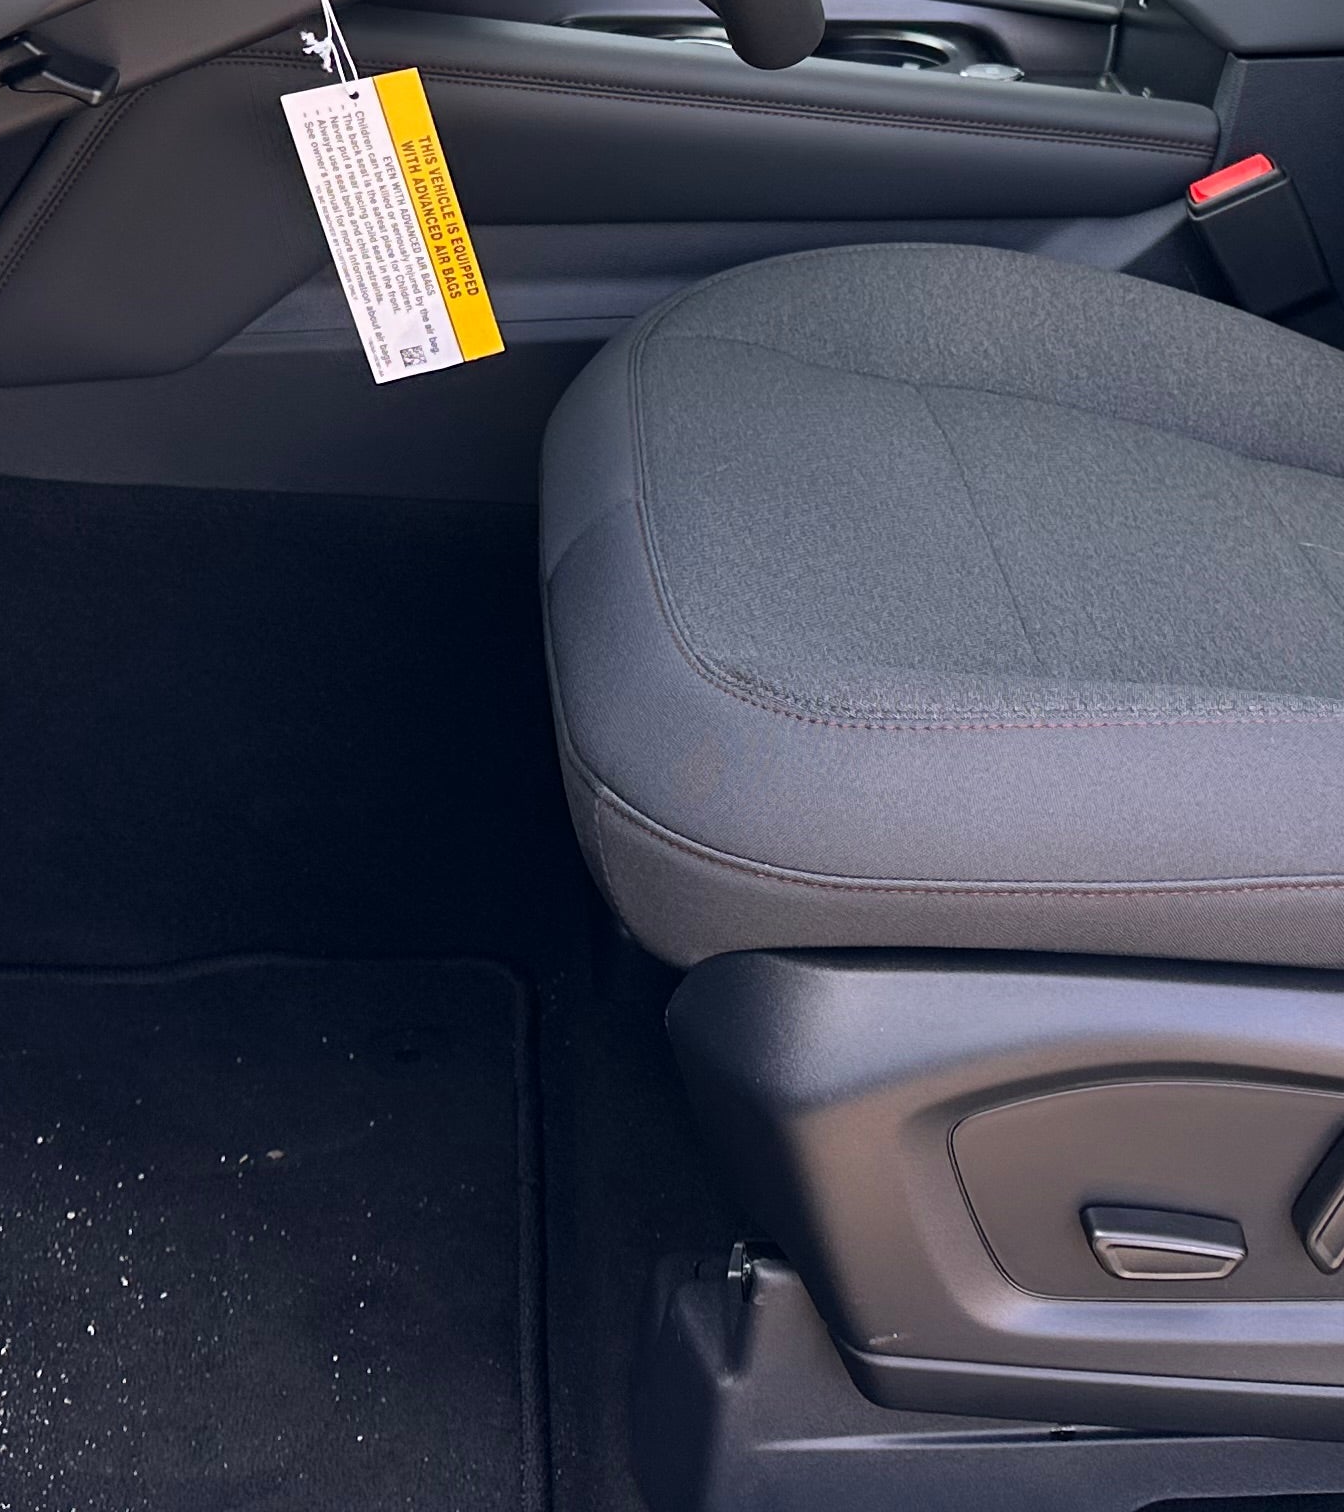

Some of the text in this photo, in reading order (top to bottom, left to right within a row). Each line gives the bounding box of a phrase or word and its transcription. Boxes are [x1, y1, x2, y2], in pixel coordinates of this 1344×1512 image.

[329, 115, 346, 143] Never
[341, 112, 355, 131] The
[354, 110, 375, 150] Children
[314, 118, 335, 153] Always
[348, 132, 363, 155] back
[328, 154, 340, 171] use
[337, 145, 351, 162] put
[367, 152, 379, 169] can
[356, 157, 370, 177] seat
[373, 170, 385, 182] be
[334, 173, 348, 193] seat
[347, 170, 359, 189] rear
[363, 178, 373, 187] is
[341, 194, 356, 217] belts
[351, 190, 370, 219] facing
[366, 189, 379, 204] the
[378, 184, 394, 209] killed
[372, 205, 388, 233] safest
[382, 155, 435, 296] EVEN WITH ADVANCED AIR BAGS
[386, 211, 396, 220] or
[400, 140, 461, 299] WITH ADVANCED AIR BAGS
[417, 135, 479, 297] THIS VEHICLE IS EQUIPPED
[303, 121, 317, 139] See
[310, 140, 330, 177] owner's
[323, 179, 341, 213] manual
[334, 214, 346, 227] for
[340, 229, 354, 252] more
[348, 253, 372, 304] information
[365, 304, 381, 330] about
[374, 331, 385, 343] air
[349, 218, 363, 236] and
[363, 220, 378, 243] child
[355, 237, 370, 259] child
[380, 234, 397, 259] place
[388, 221, 411, 262] seriously
[371, 244, 385, 263] seat
[378, 264, 388, 273] in
[390, 259, 401, 272] for
[382, 275, 394, 289] the
[402, 263, 421, 294] injured
[413, 295, 426, 307] by
[419, 308, 431, 322] the
[424, 323, 435, 335] air
